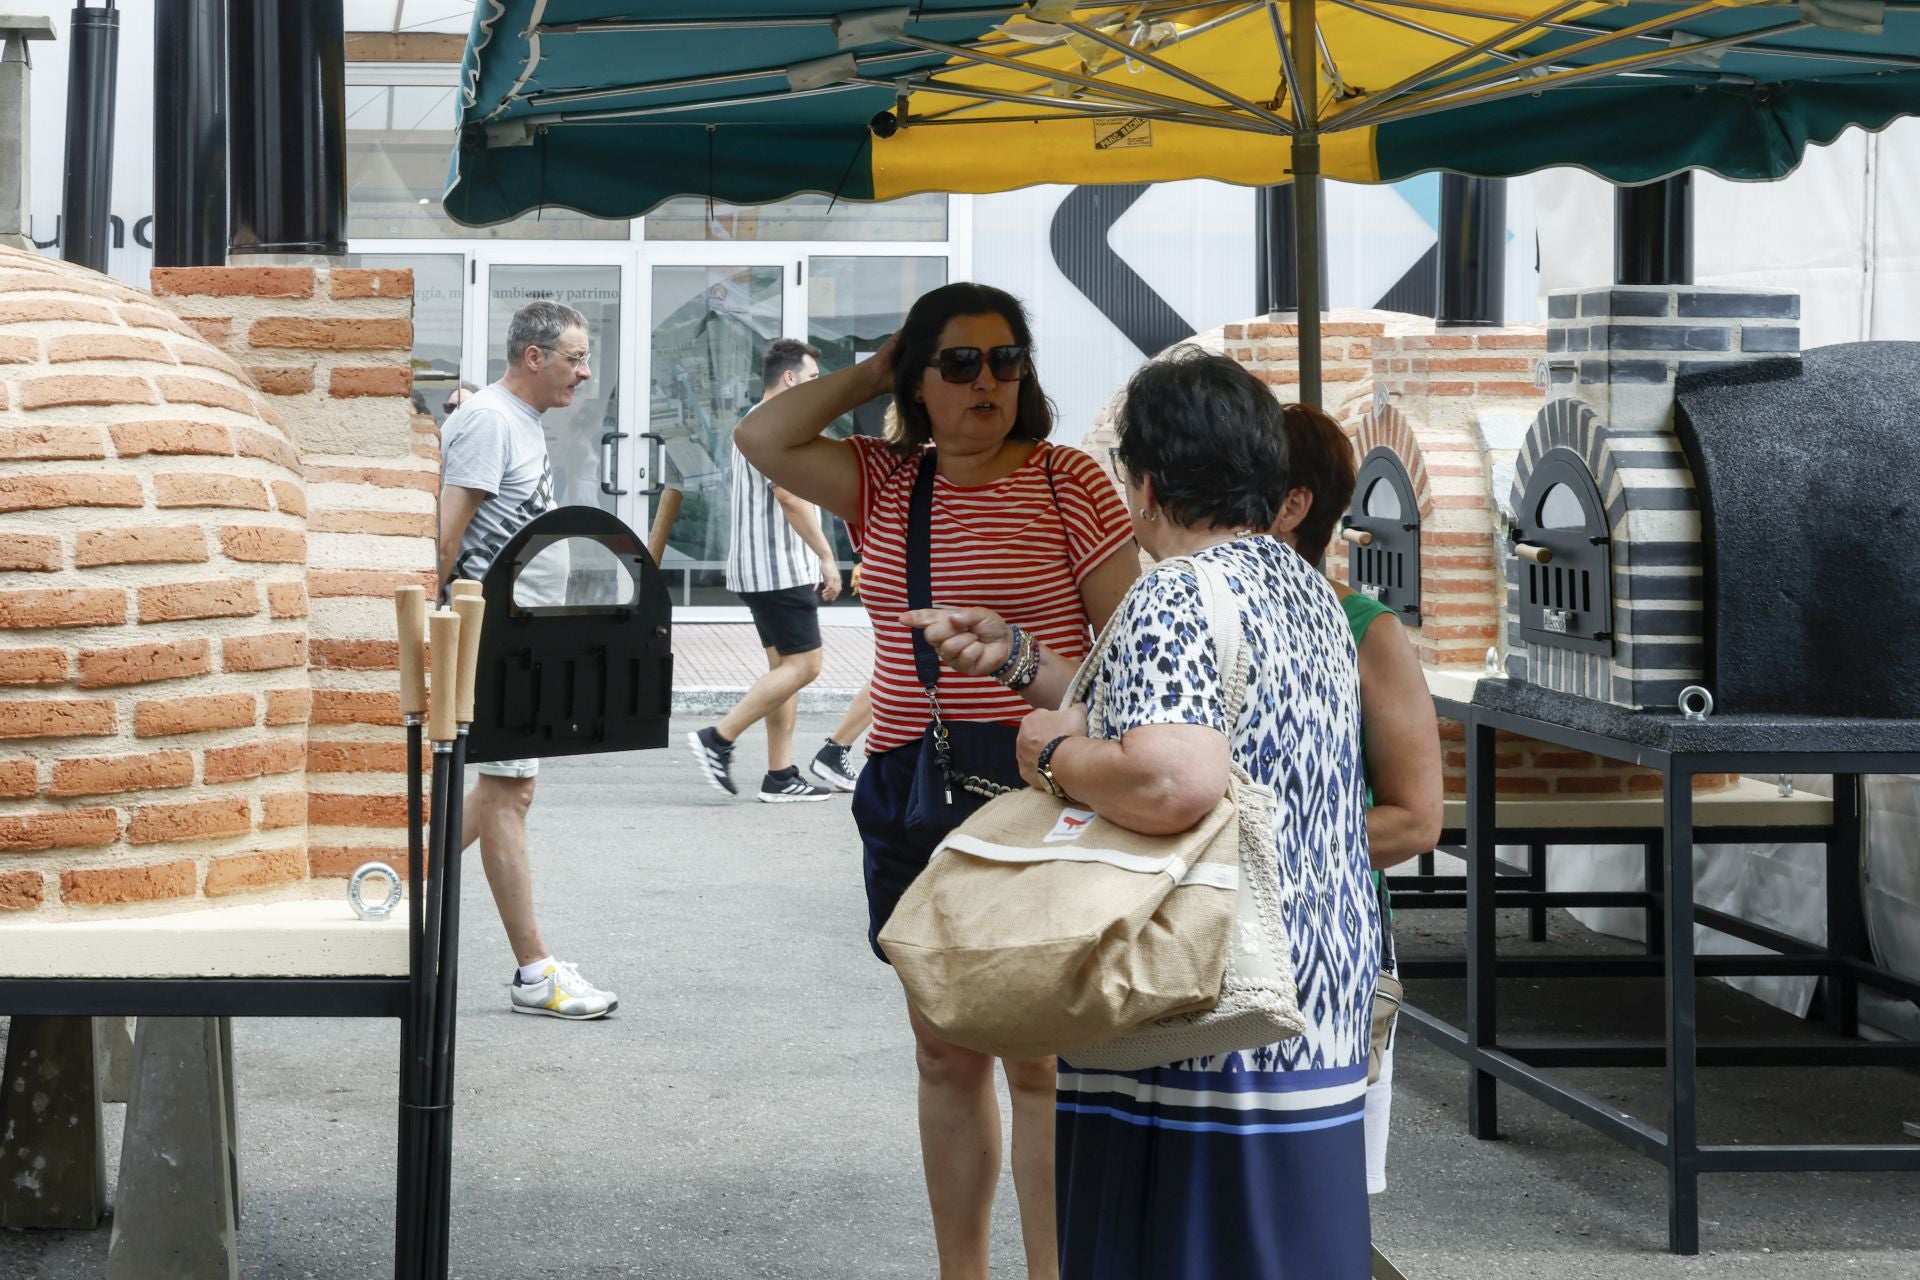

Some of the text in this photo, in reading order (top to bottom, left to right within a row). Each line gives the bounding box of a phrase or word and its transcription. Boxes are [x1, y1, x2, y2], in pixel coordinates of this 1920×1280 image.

[1100, 133, 1121, 149] PARIS
[493, 287, 552, 299] ambiente
[556, 290, 566, 302] y
[567, 287, 619, 301] patrimo
